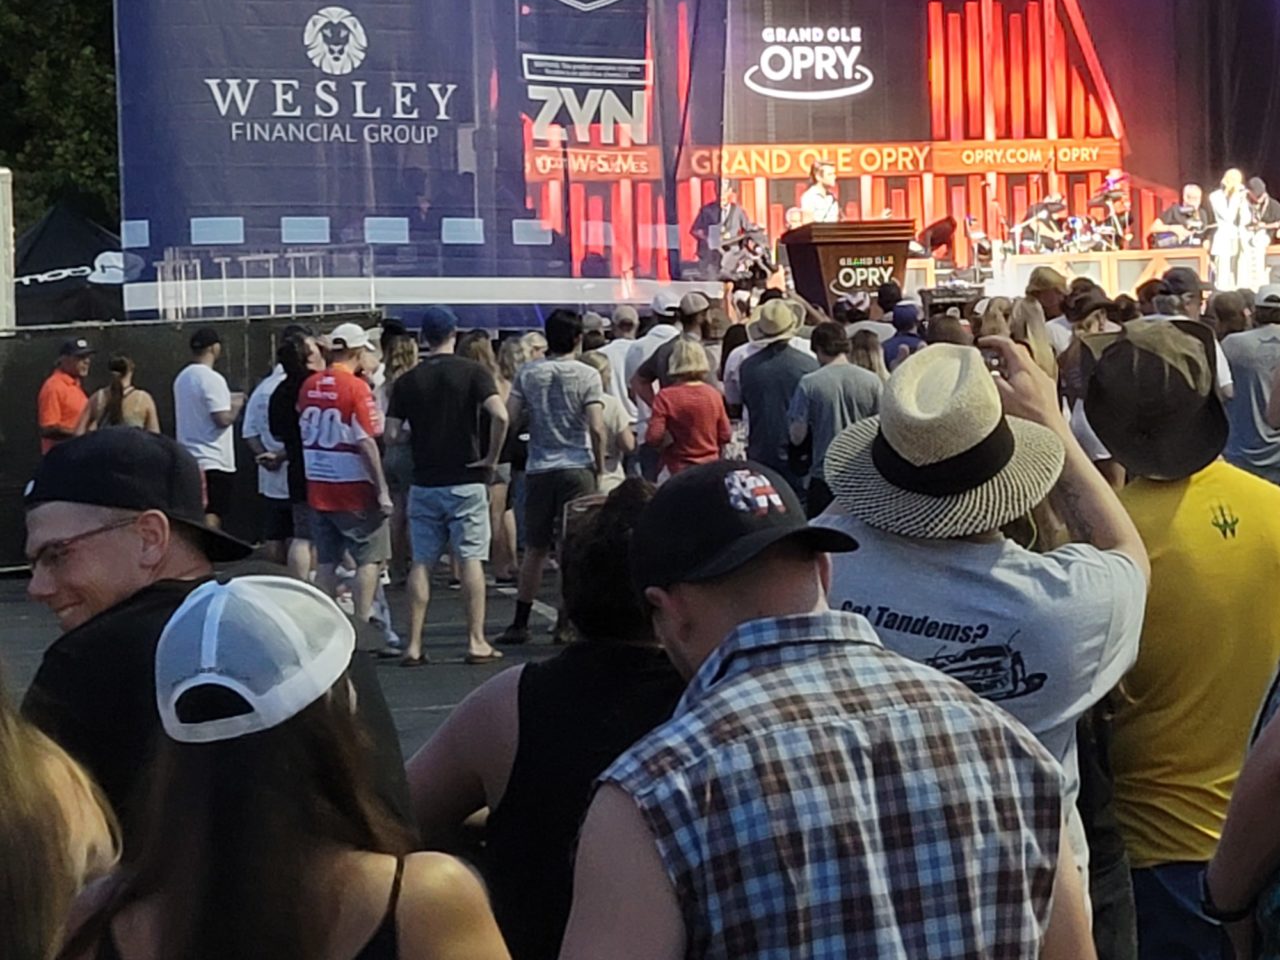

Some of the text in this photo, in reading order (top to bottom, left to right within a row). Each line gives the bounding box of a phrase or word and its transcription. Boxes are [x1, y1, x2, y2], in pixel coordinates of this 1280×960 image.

[762, 27, 862, 43] GRAND OLE
[204, 78, 458, 120] WESLEY
[528, 85, 649, 145] ZYN
[231, 121, 439, 144] FINANCIAL GROUP
[691, 145, 792, 176] GRAND
[859, 145, 931, 172] OPRY
[962, 147, 1042, 165] OPRY.COM
[1058, 146, 1100, 162] OPRY
[838, 266, 893, 288] OPRY
[874, 605, 990, 644] Tandems?
